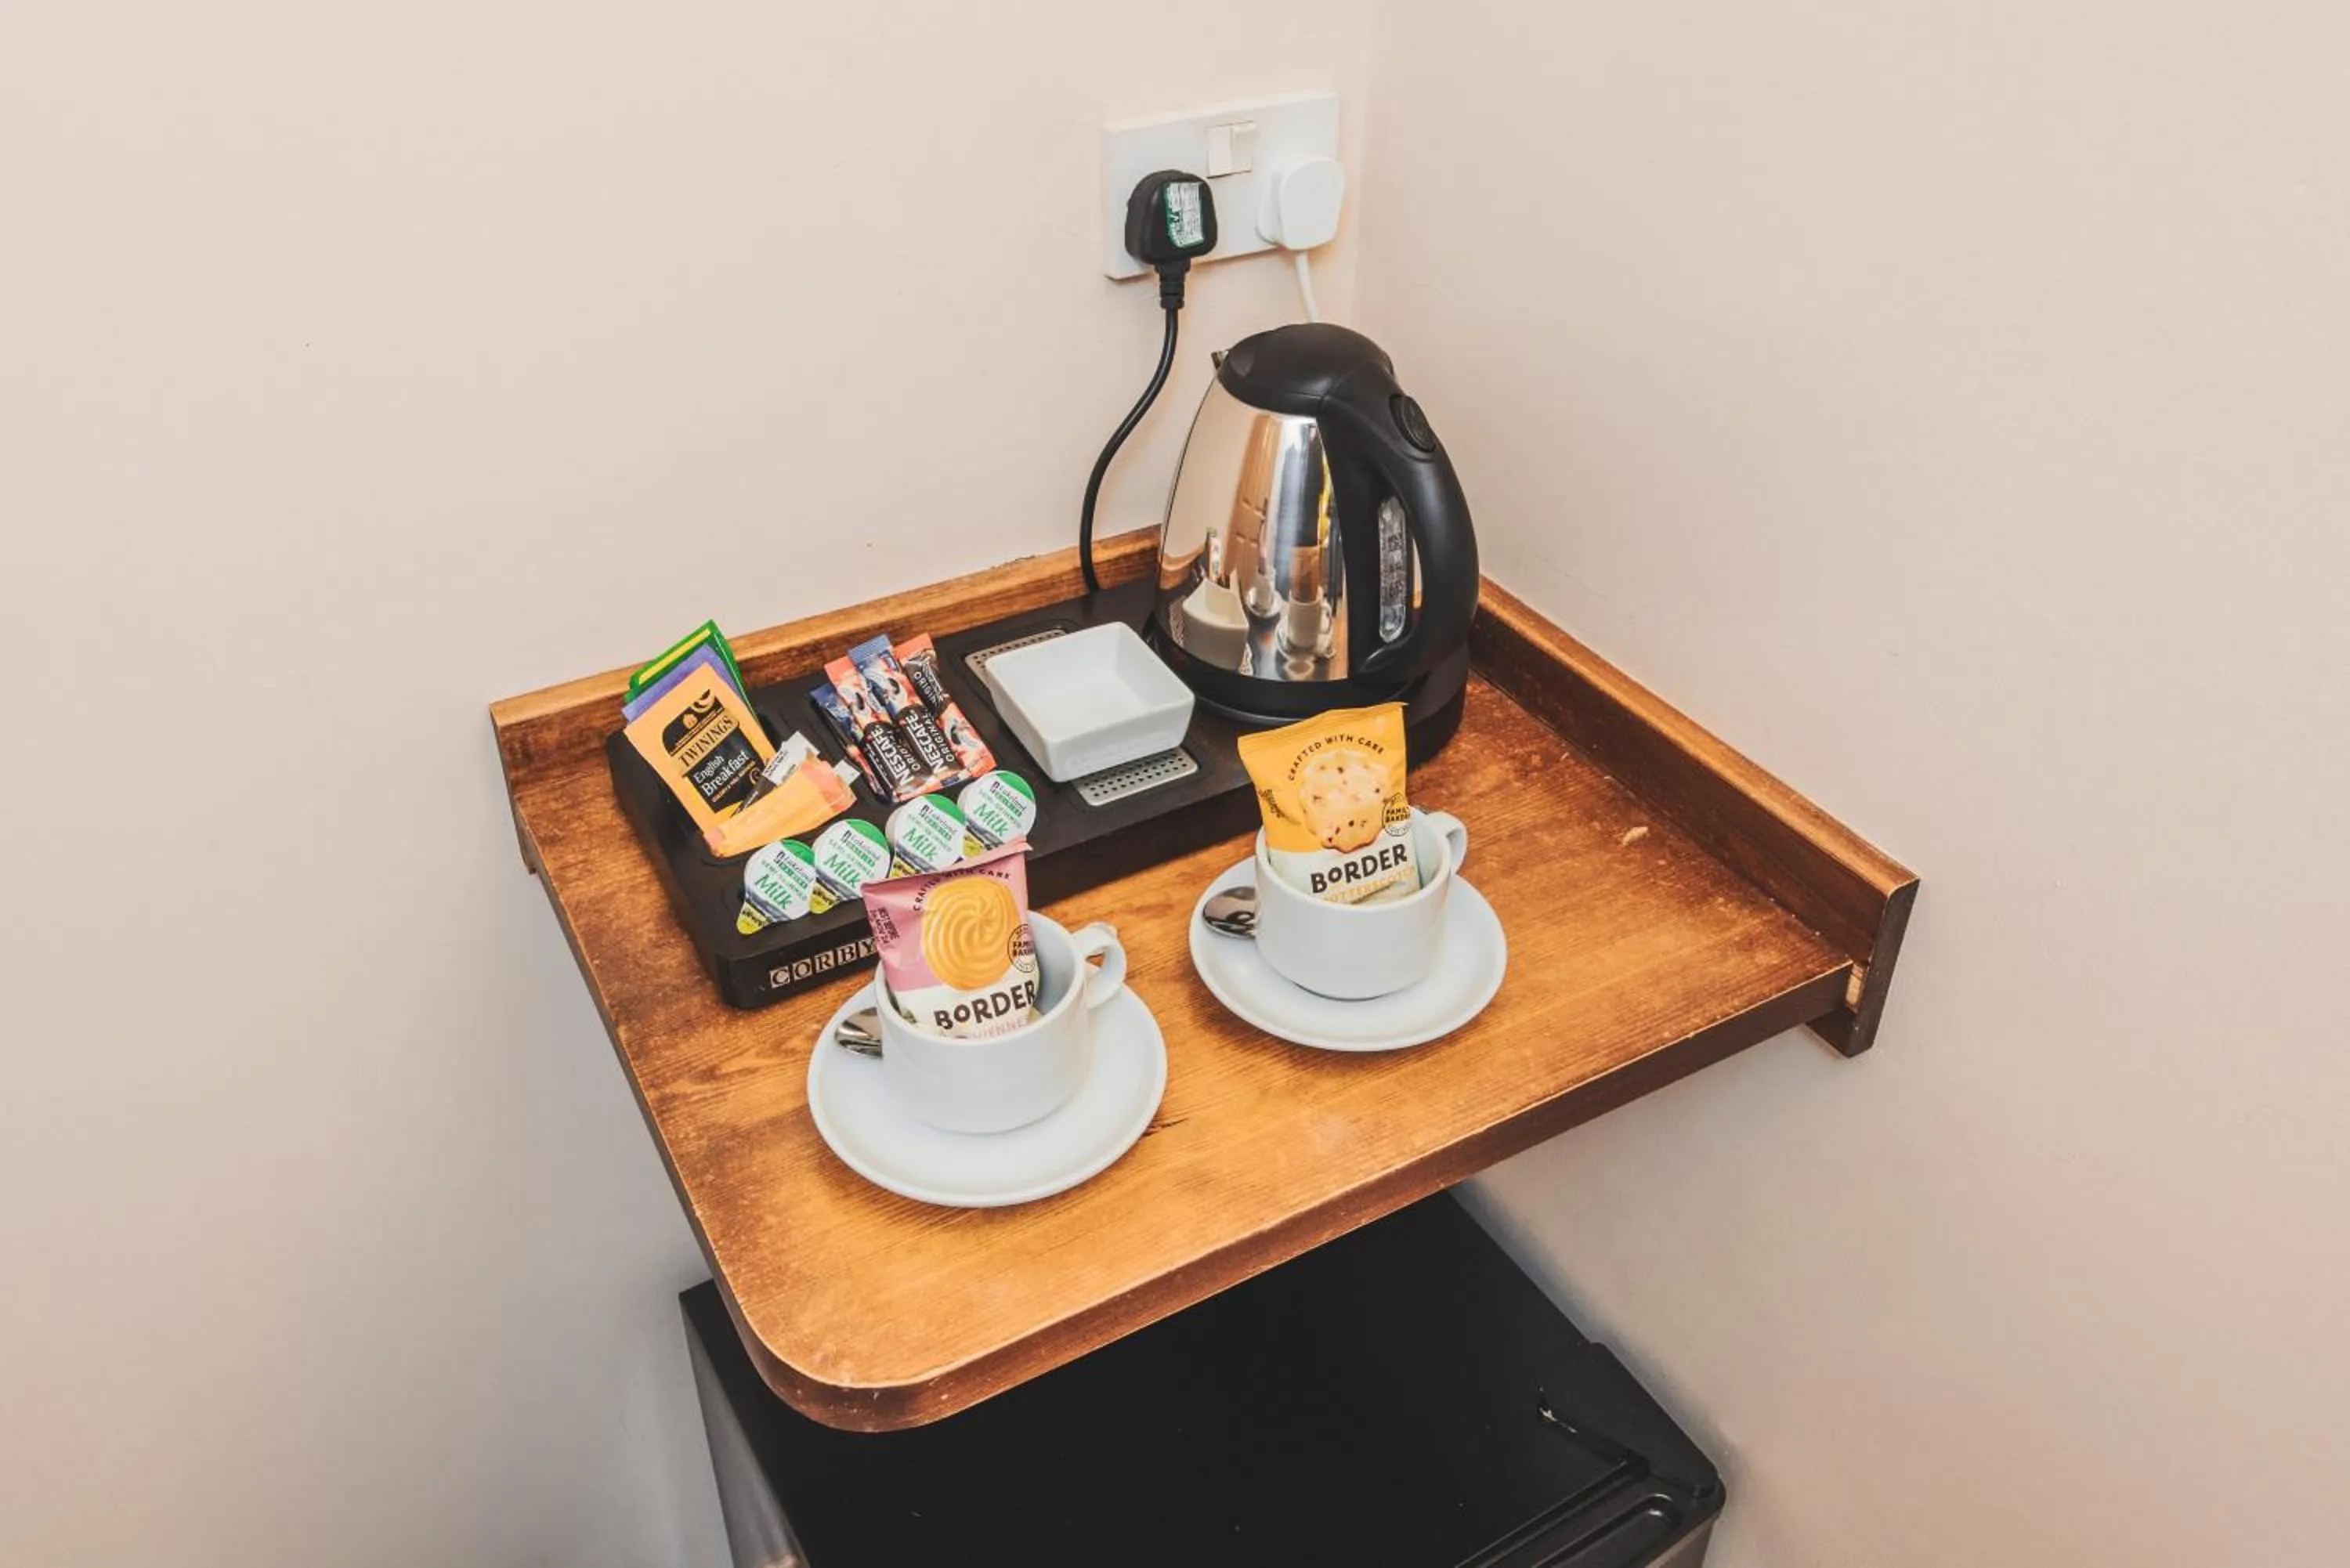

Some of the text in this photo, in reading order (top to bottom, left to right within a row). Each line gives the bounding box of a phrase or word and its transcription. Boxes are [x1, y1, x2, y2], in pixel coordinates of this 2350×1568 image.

[678, 715, 733, 767] TWININGS
[923, 713, 955, 762] ORIGINAL
[1288, 733, 1384, 781] CRAFTED WITH CARE
[693, 755, 725, 784] English
[701, 750, 750, 797] Breakfast
[973, 803, 1009, 836] Milk
[902, 827, 938, 862] Milk
[754, 874, 792, 909] Milk
[823, 854, 860, 889] Milk
[978, 869, 1010, 879] CARE
[1311, 844, 1408, 894] BORDER
[772, 938, 875, 986] CORBY
[934, 980, 1036, 1029] BORDER
